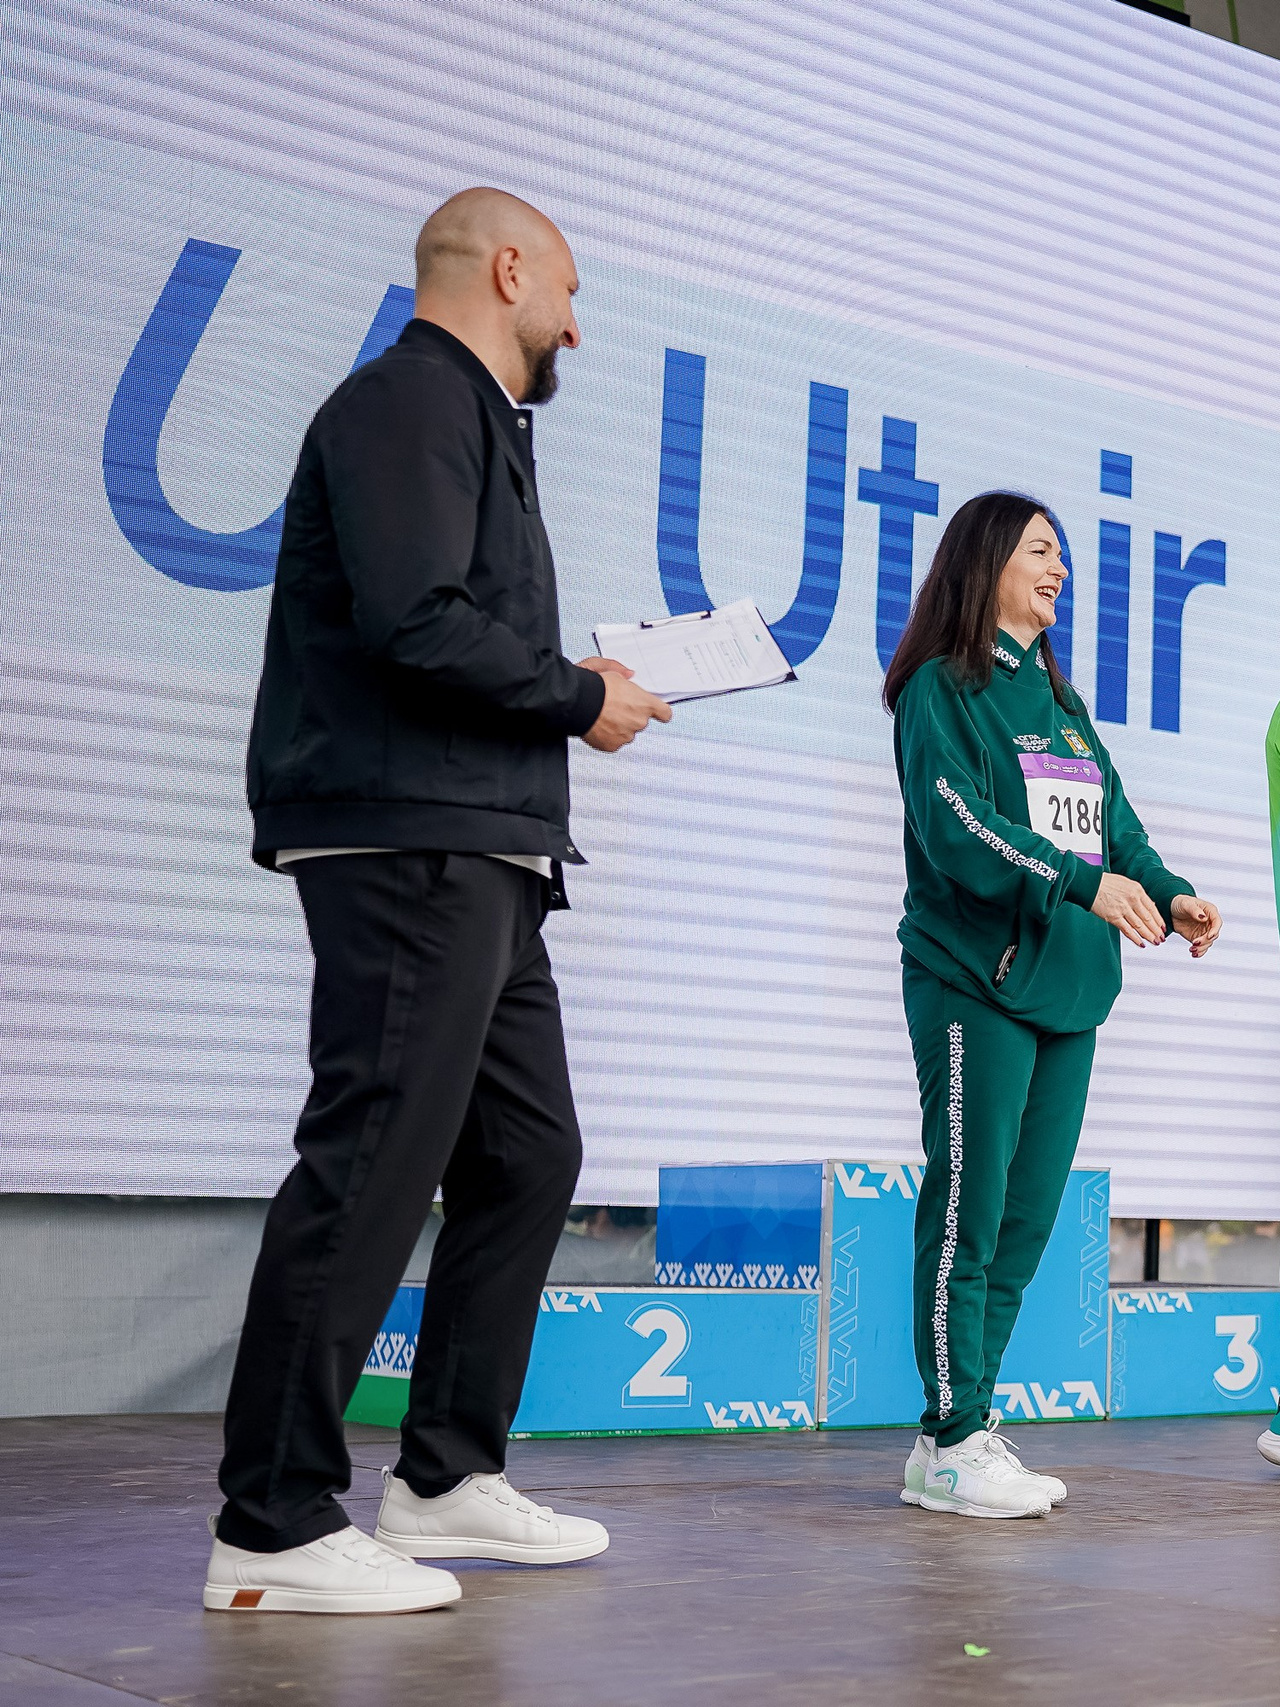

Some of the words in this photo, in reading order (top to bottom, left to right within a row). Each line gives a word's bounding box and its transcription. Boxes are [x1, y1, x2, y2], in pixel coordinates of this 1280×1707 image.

[657, 347, 1226, 733] Utir
[1048, 795, 1101, 836] 2186
[622, 1301, 692, 1408] 2
[1213, 1314, 1263, 1400] 3
